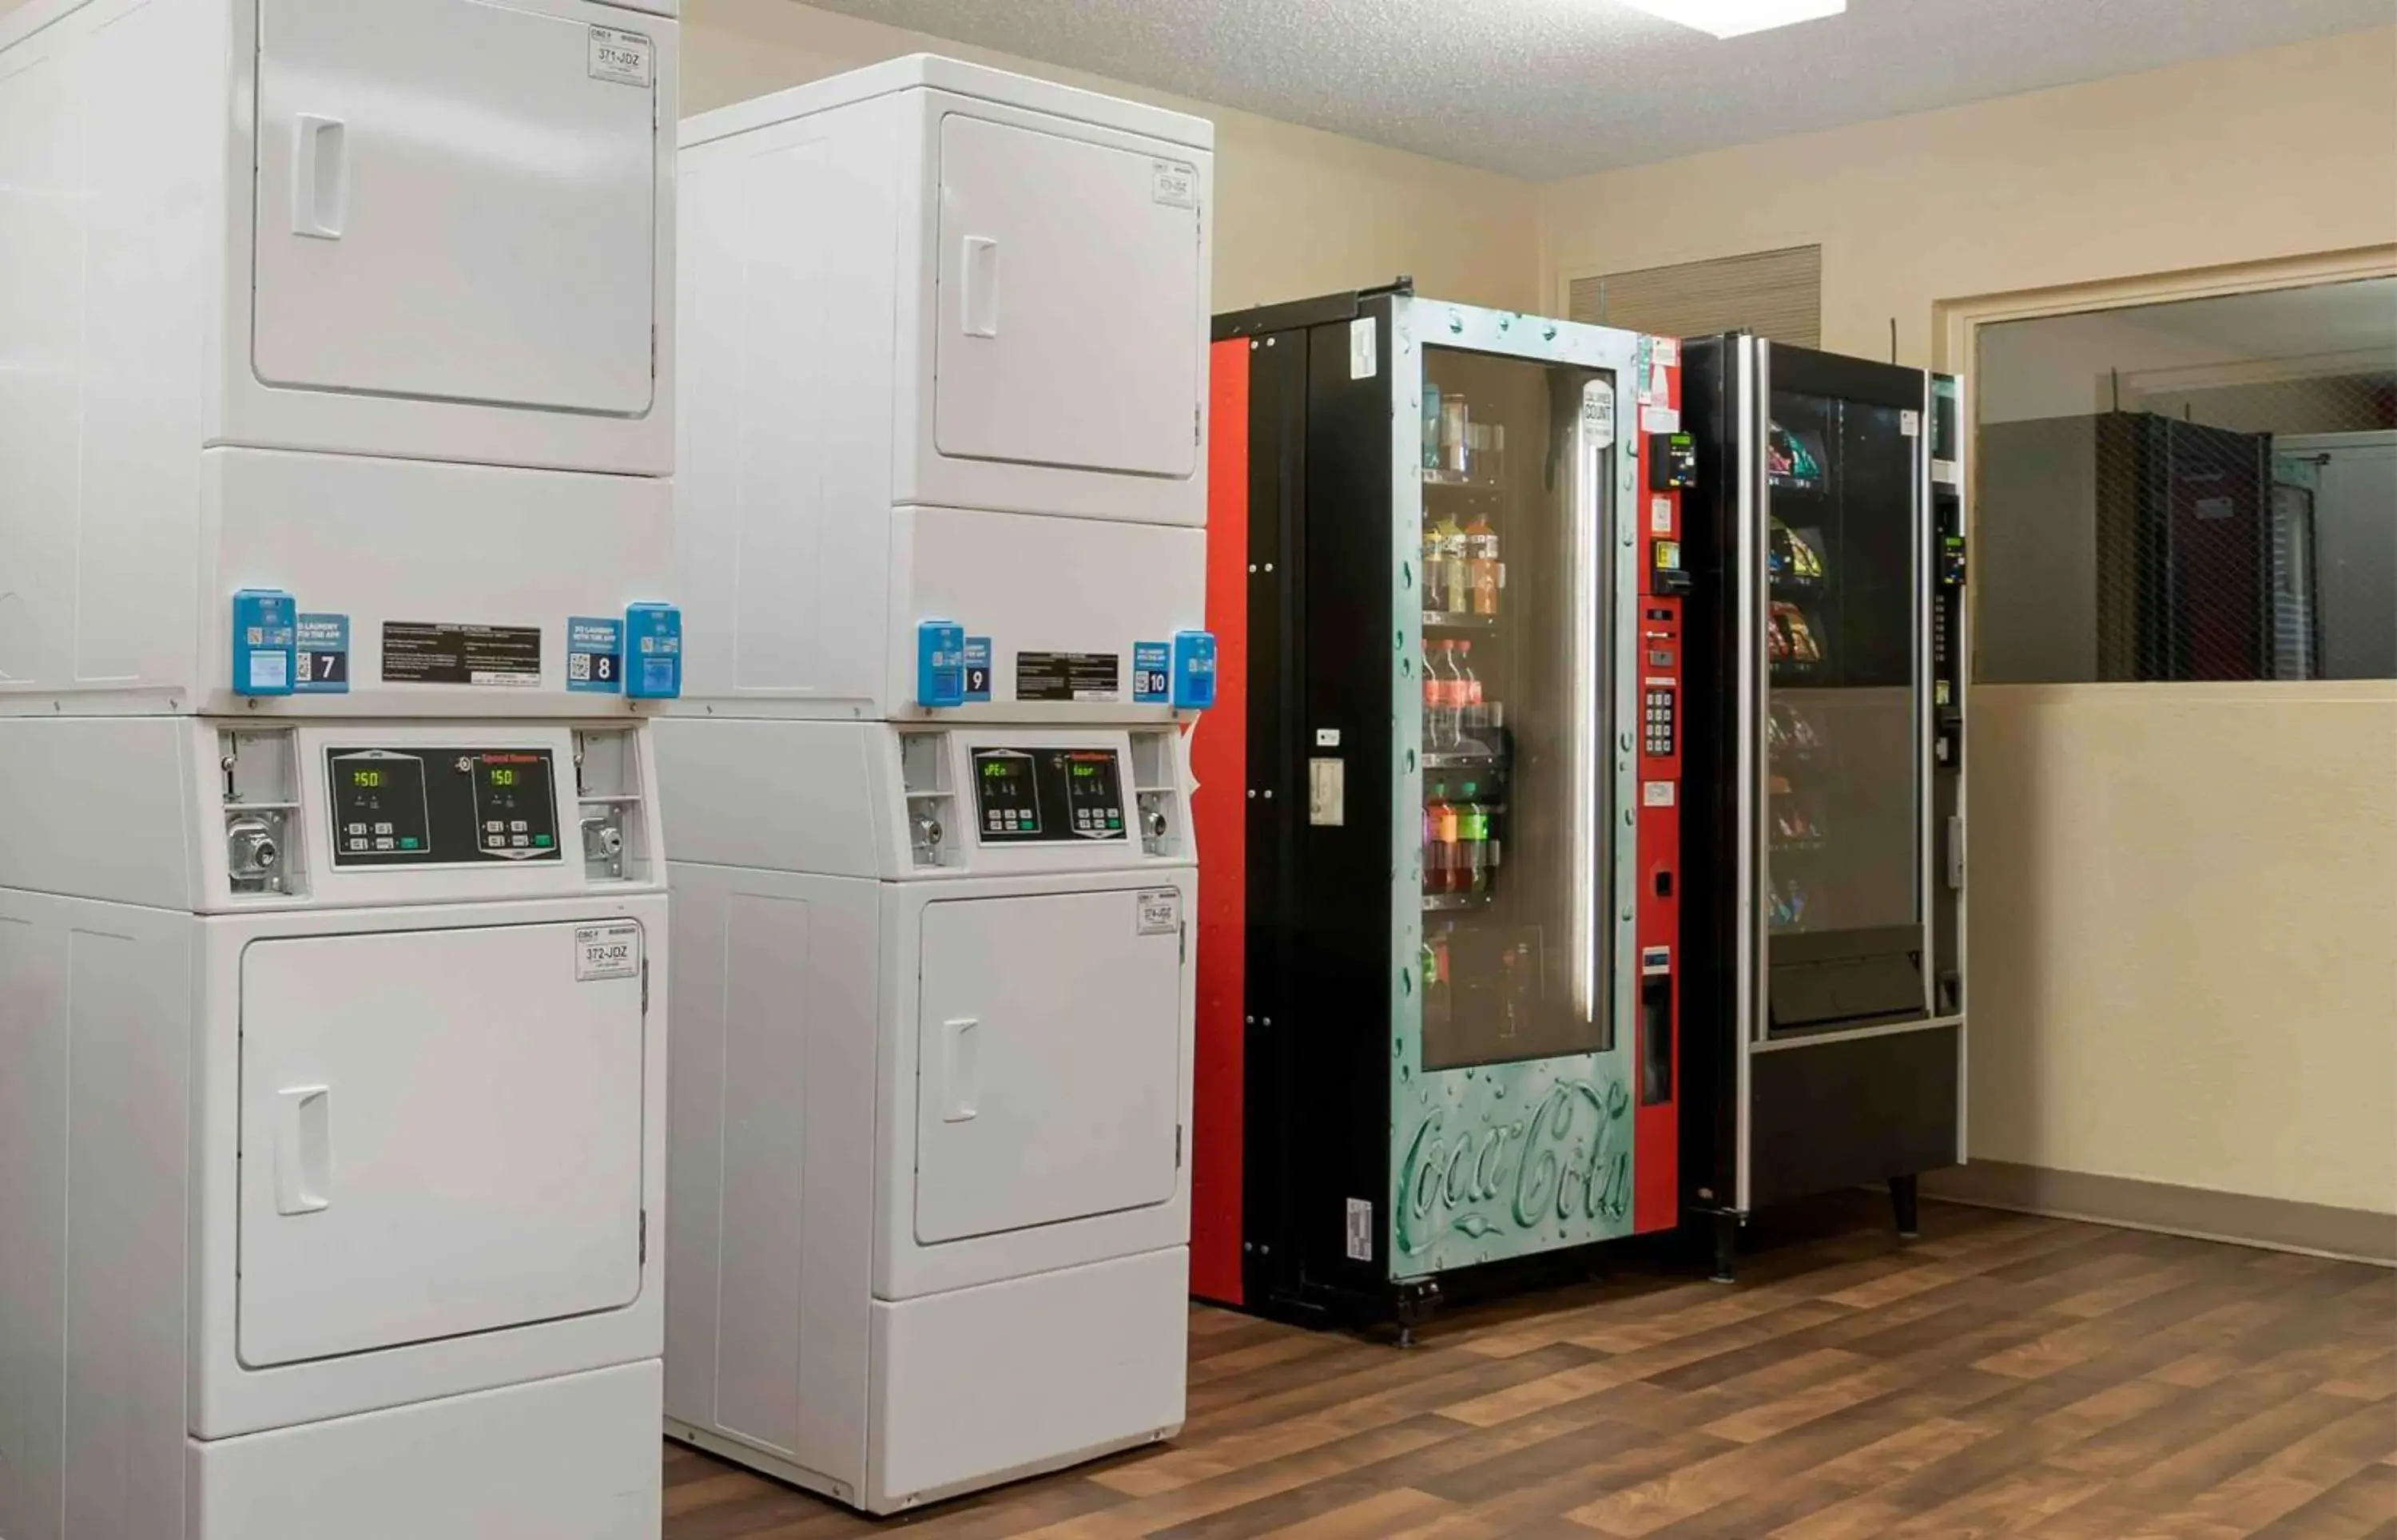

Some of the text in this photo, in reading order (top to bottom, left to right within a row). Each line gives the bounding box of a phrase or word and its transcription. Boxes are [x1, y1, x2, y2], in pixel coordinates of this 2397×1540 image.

[598, 48, 640, 65] 371-JDZ
[1585, 403, 1612, 421] COUNT
[321, 656, 336, 678] 7
[598, 657, 610, 679] 8
[972, 671, 983, 689] 9
[1151, 674, 1165, 692] 10
[586, 945, 627, 960] 372-JDZ
